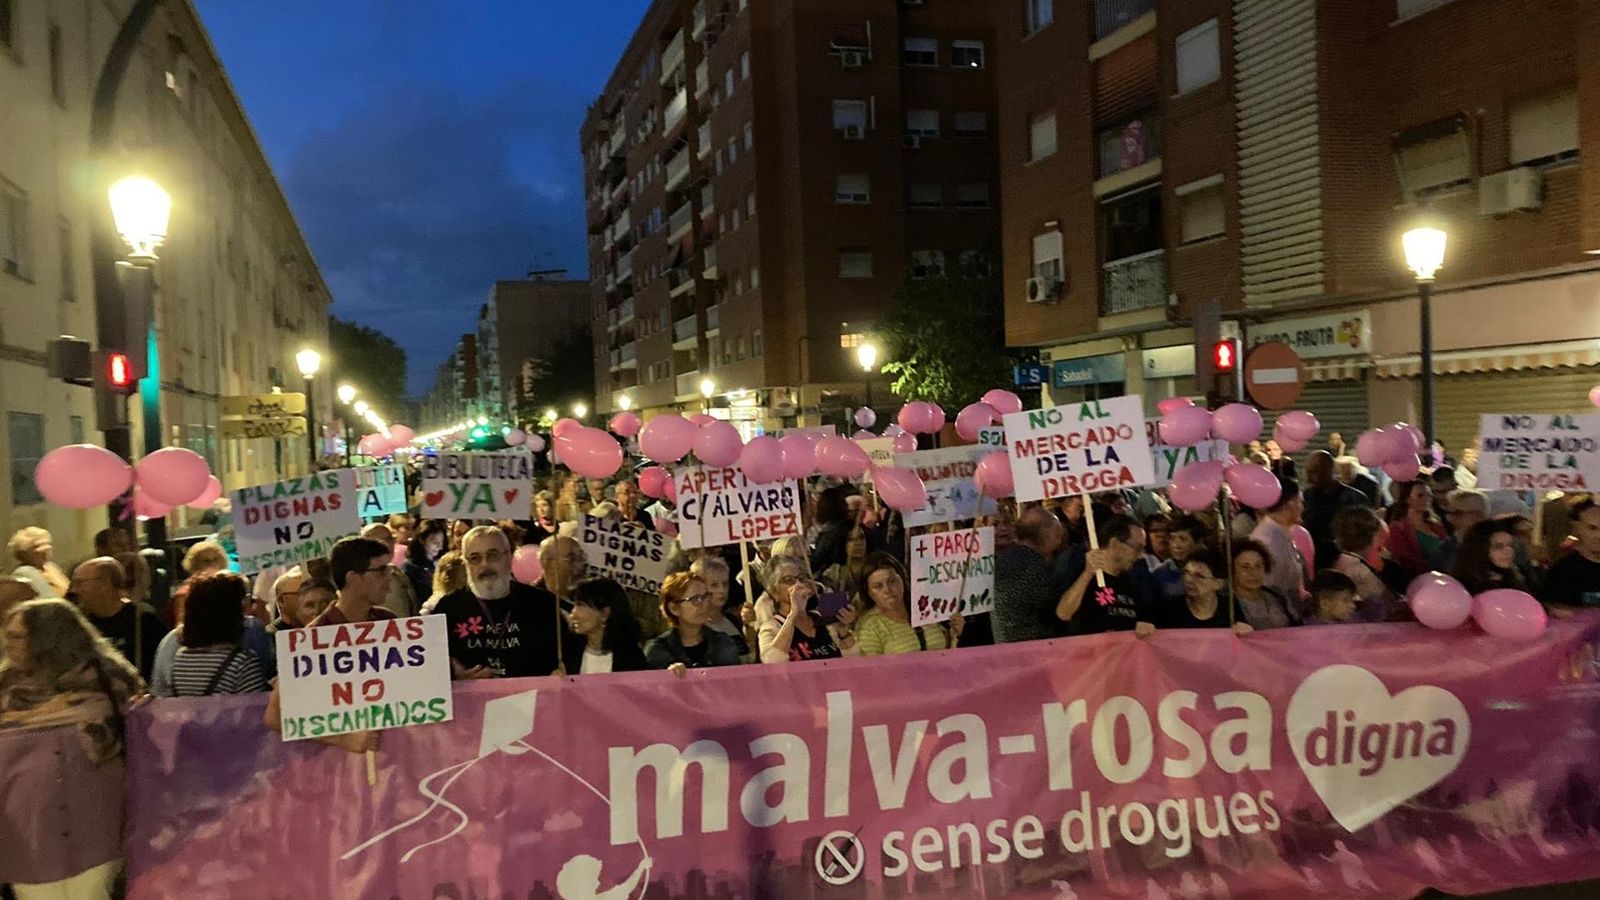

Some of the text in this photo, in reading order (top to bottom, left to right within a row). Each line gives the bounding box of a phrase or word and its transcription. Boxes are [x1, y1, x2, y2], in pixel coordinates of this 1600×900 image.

[1029, 400, 1110, 430] NO AL
[1502, 415, 1579, 430] NO AL
[1014, 424, 1133, 459] MERCADO
[1483, 437, 1596, 453] MERCADO
[423, 454, 533, 480] BIBLIOTECA
[1037, 445, 1120, 476] DE LA
[1500, 454, 1577, 469] DE LA
[238, 472, 339, 506] PLAZAS
[1041, 466, 1136, 498] DROGA
[1501, 473, 1586, 489] DROGA
[244, 493, 342, 526] DIGNAS
[447, 483, 497, 513] YA
[273, 521, 314, 545] NO
[585, 514, 663, 547] PLAZAS
[727, 513, 798, 541] LÓPEZ
[583, 529, 663, 562] DIGNAS
[604, 552, 635, 571] NO
[288, 618, 424, 652] PLAZAS
[293, 645, 426, 678] DIGNAS
[331, 678, 385, 706] NO
[284, 697, 447, 738] DESCAMPADOS
[1304, 710, 1457, 778] digna
[608, 689, 1273, 845] malva-rosa
[882, 790, 1282, 878] sense drogues
